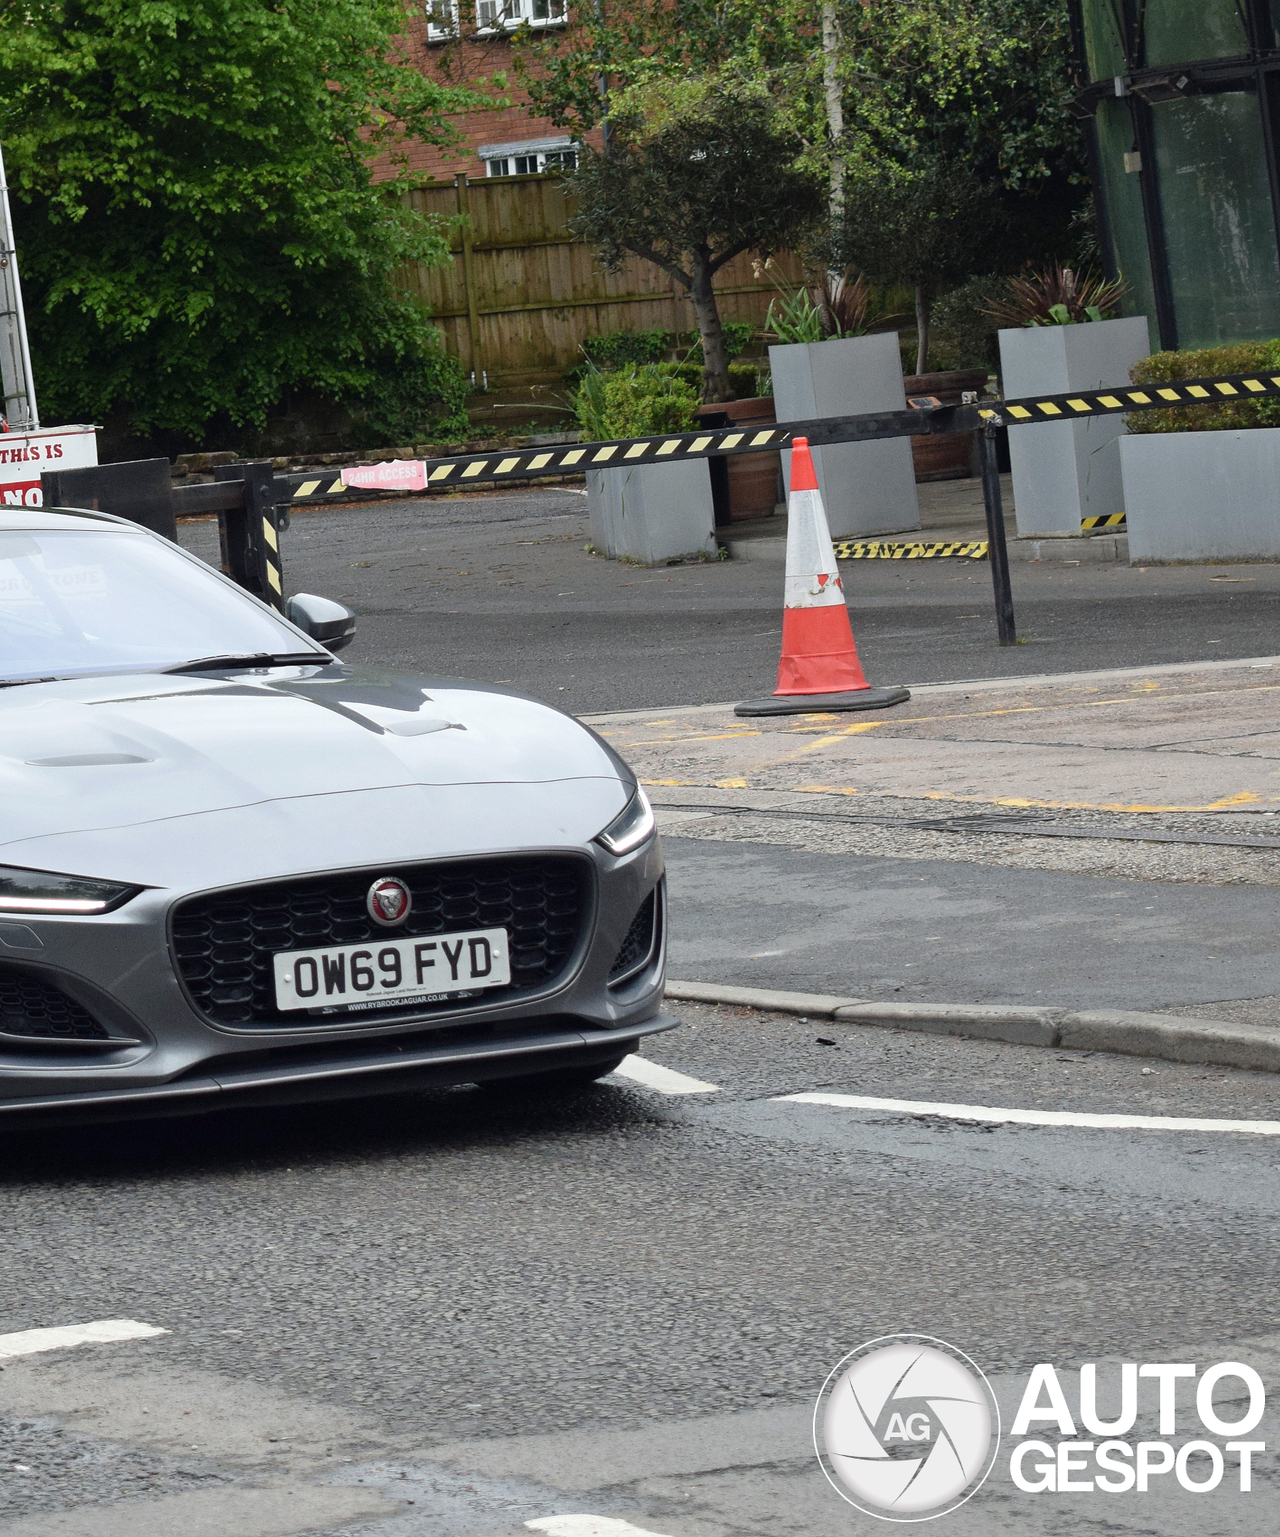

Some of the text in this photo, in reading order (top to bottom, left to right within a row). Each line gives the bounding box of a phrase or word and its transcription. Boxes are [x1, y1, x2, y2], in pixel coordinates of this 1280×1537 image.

[0, 444, 63, 463] THIS IS
[348, 465, 417, 485] 24HR ACCESS
[4, 487, 44, 507] NO
[293, 936, 492, 998] OW69 FYD
[347, 993, 448, 1011] WWW.RYBROOKJAGUAR.CO.UK
